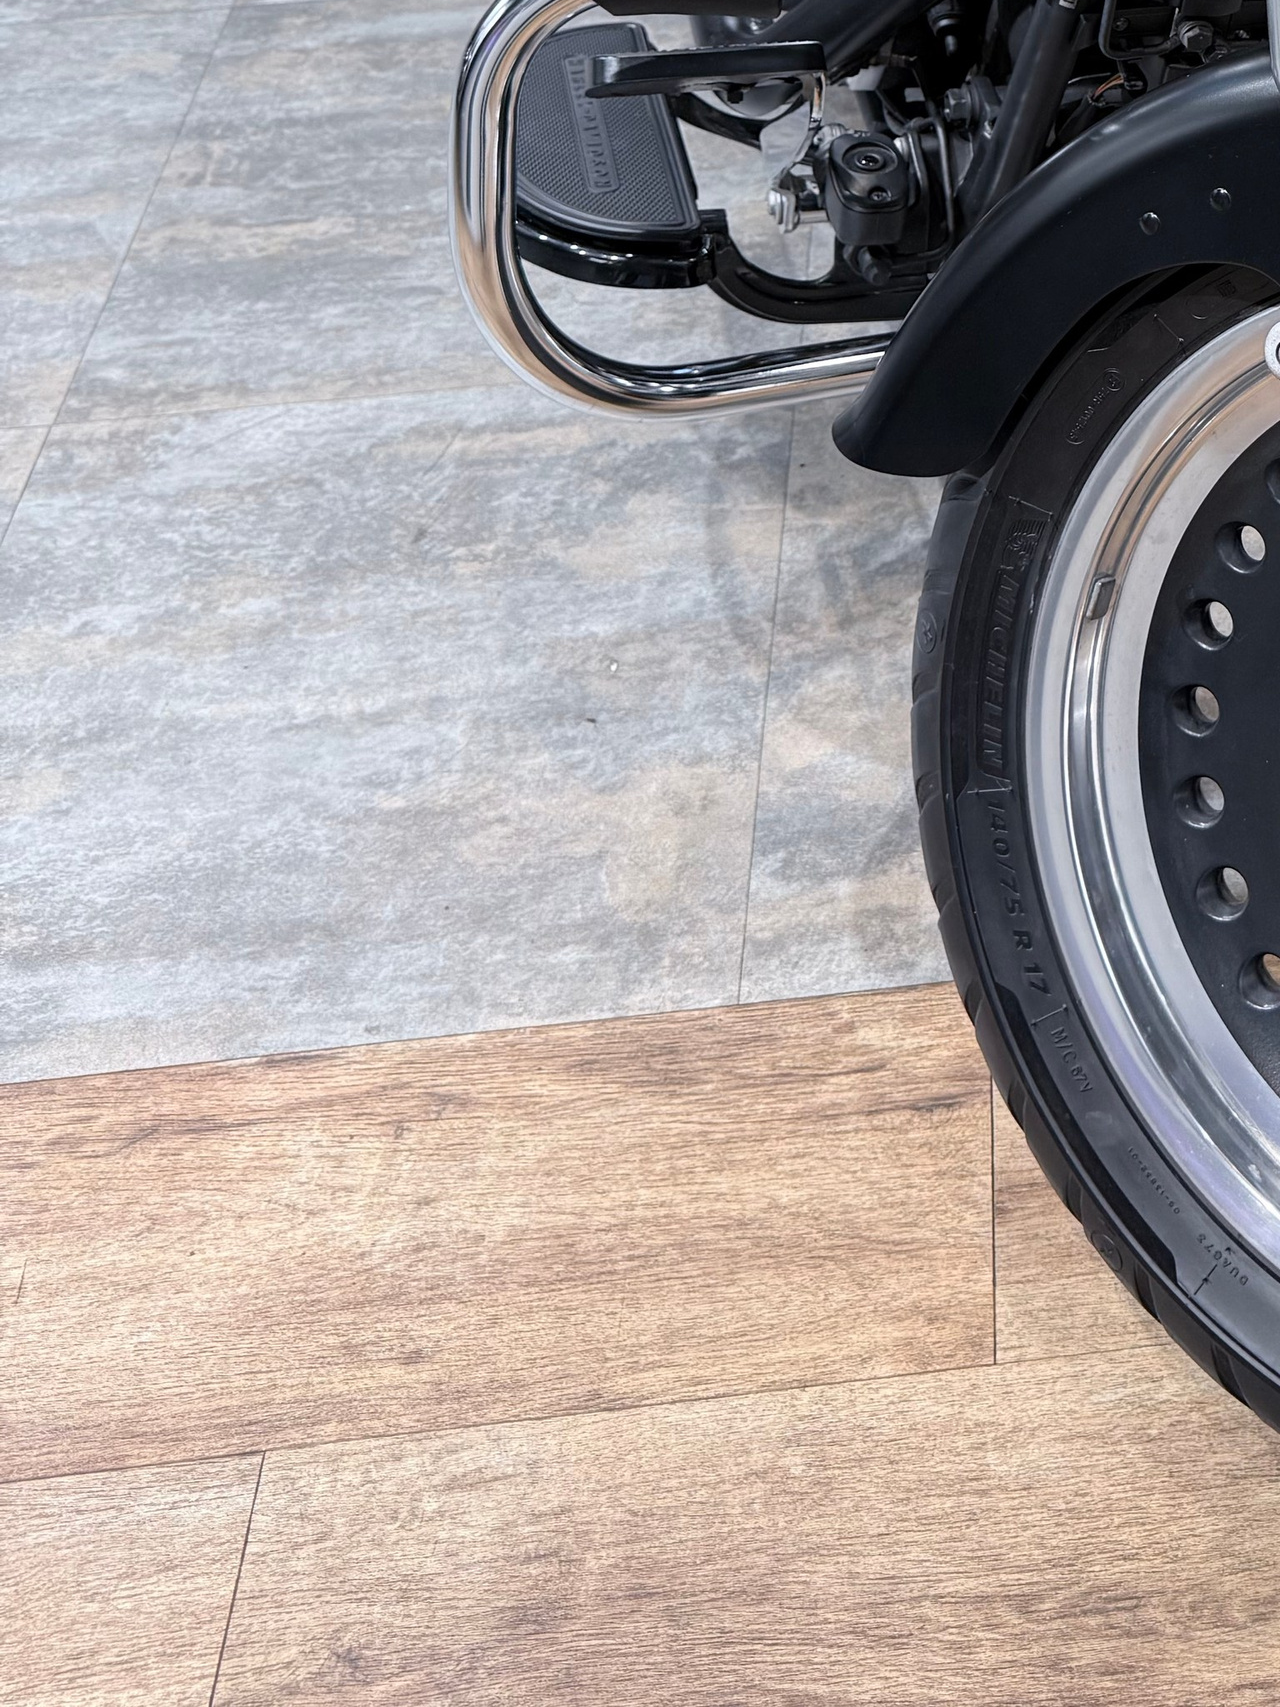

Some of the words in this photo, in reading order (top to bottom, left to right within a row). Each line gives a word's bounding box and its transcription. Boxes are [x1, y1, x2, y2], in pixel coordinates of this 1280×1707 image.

[983, 574, 1020, 768] MICHELIN
[983, 799, 1026, 918] 140/75
[1010, 926, 1035, 953] R
[1021, 960, 1052, 996] 17
[1047, 1024, 1081, 1064] M/C
